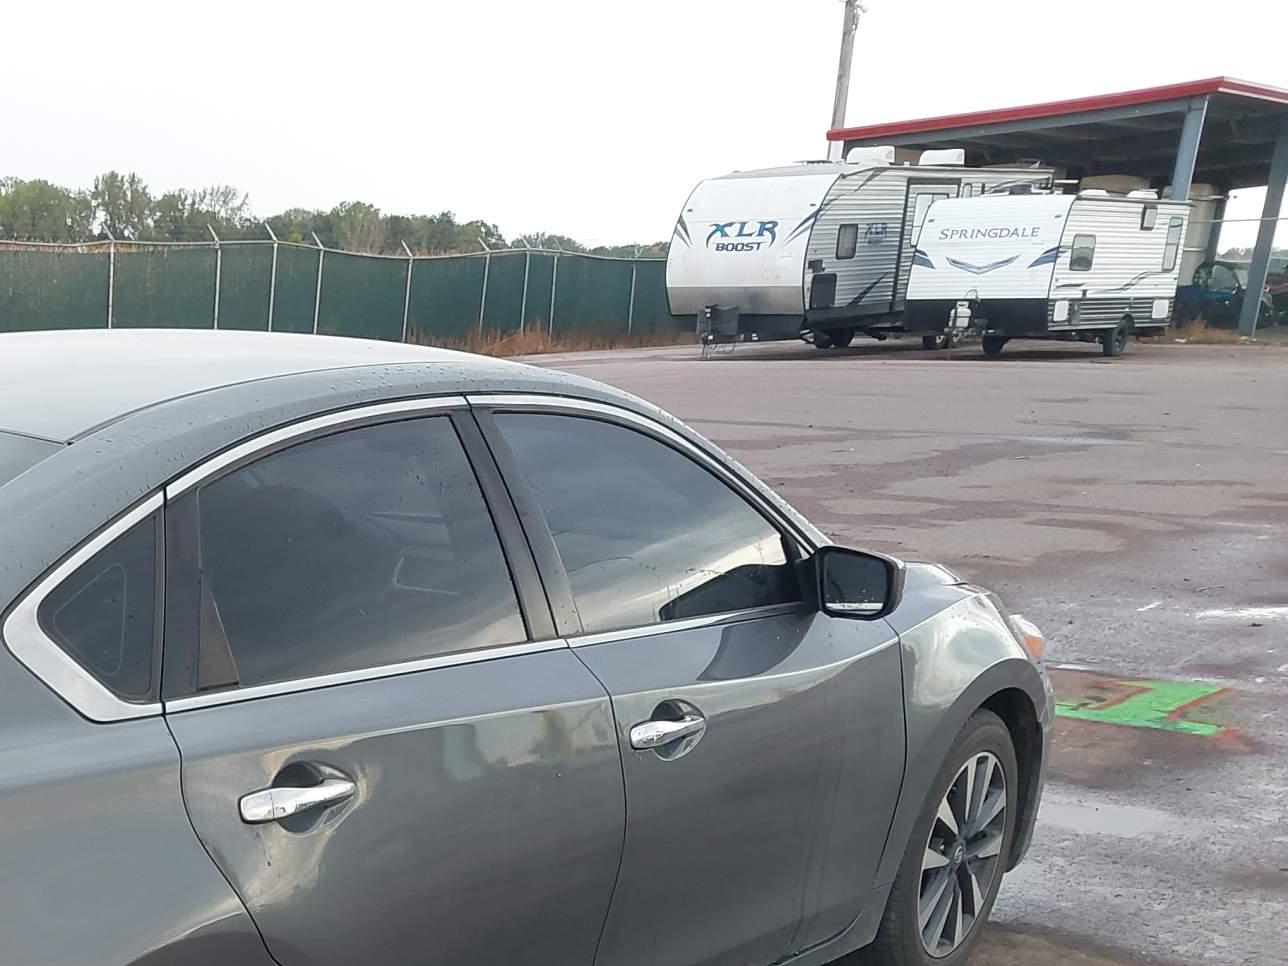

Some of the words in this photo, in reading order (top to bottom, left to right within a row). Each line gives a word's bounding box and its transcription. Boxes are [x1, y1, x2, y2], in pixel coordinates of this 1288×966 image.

[706, 220, 778, 248] XLR
[938, 226, 1041, 240] SPRINGDALE
[715, 241, 762, 252] BOOST
